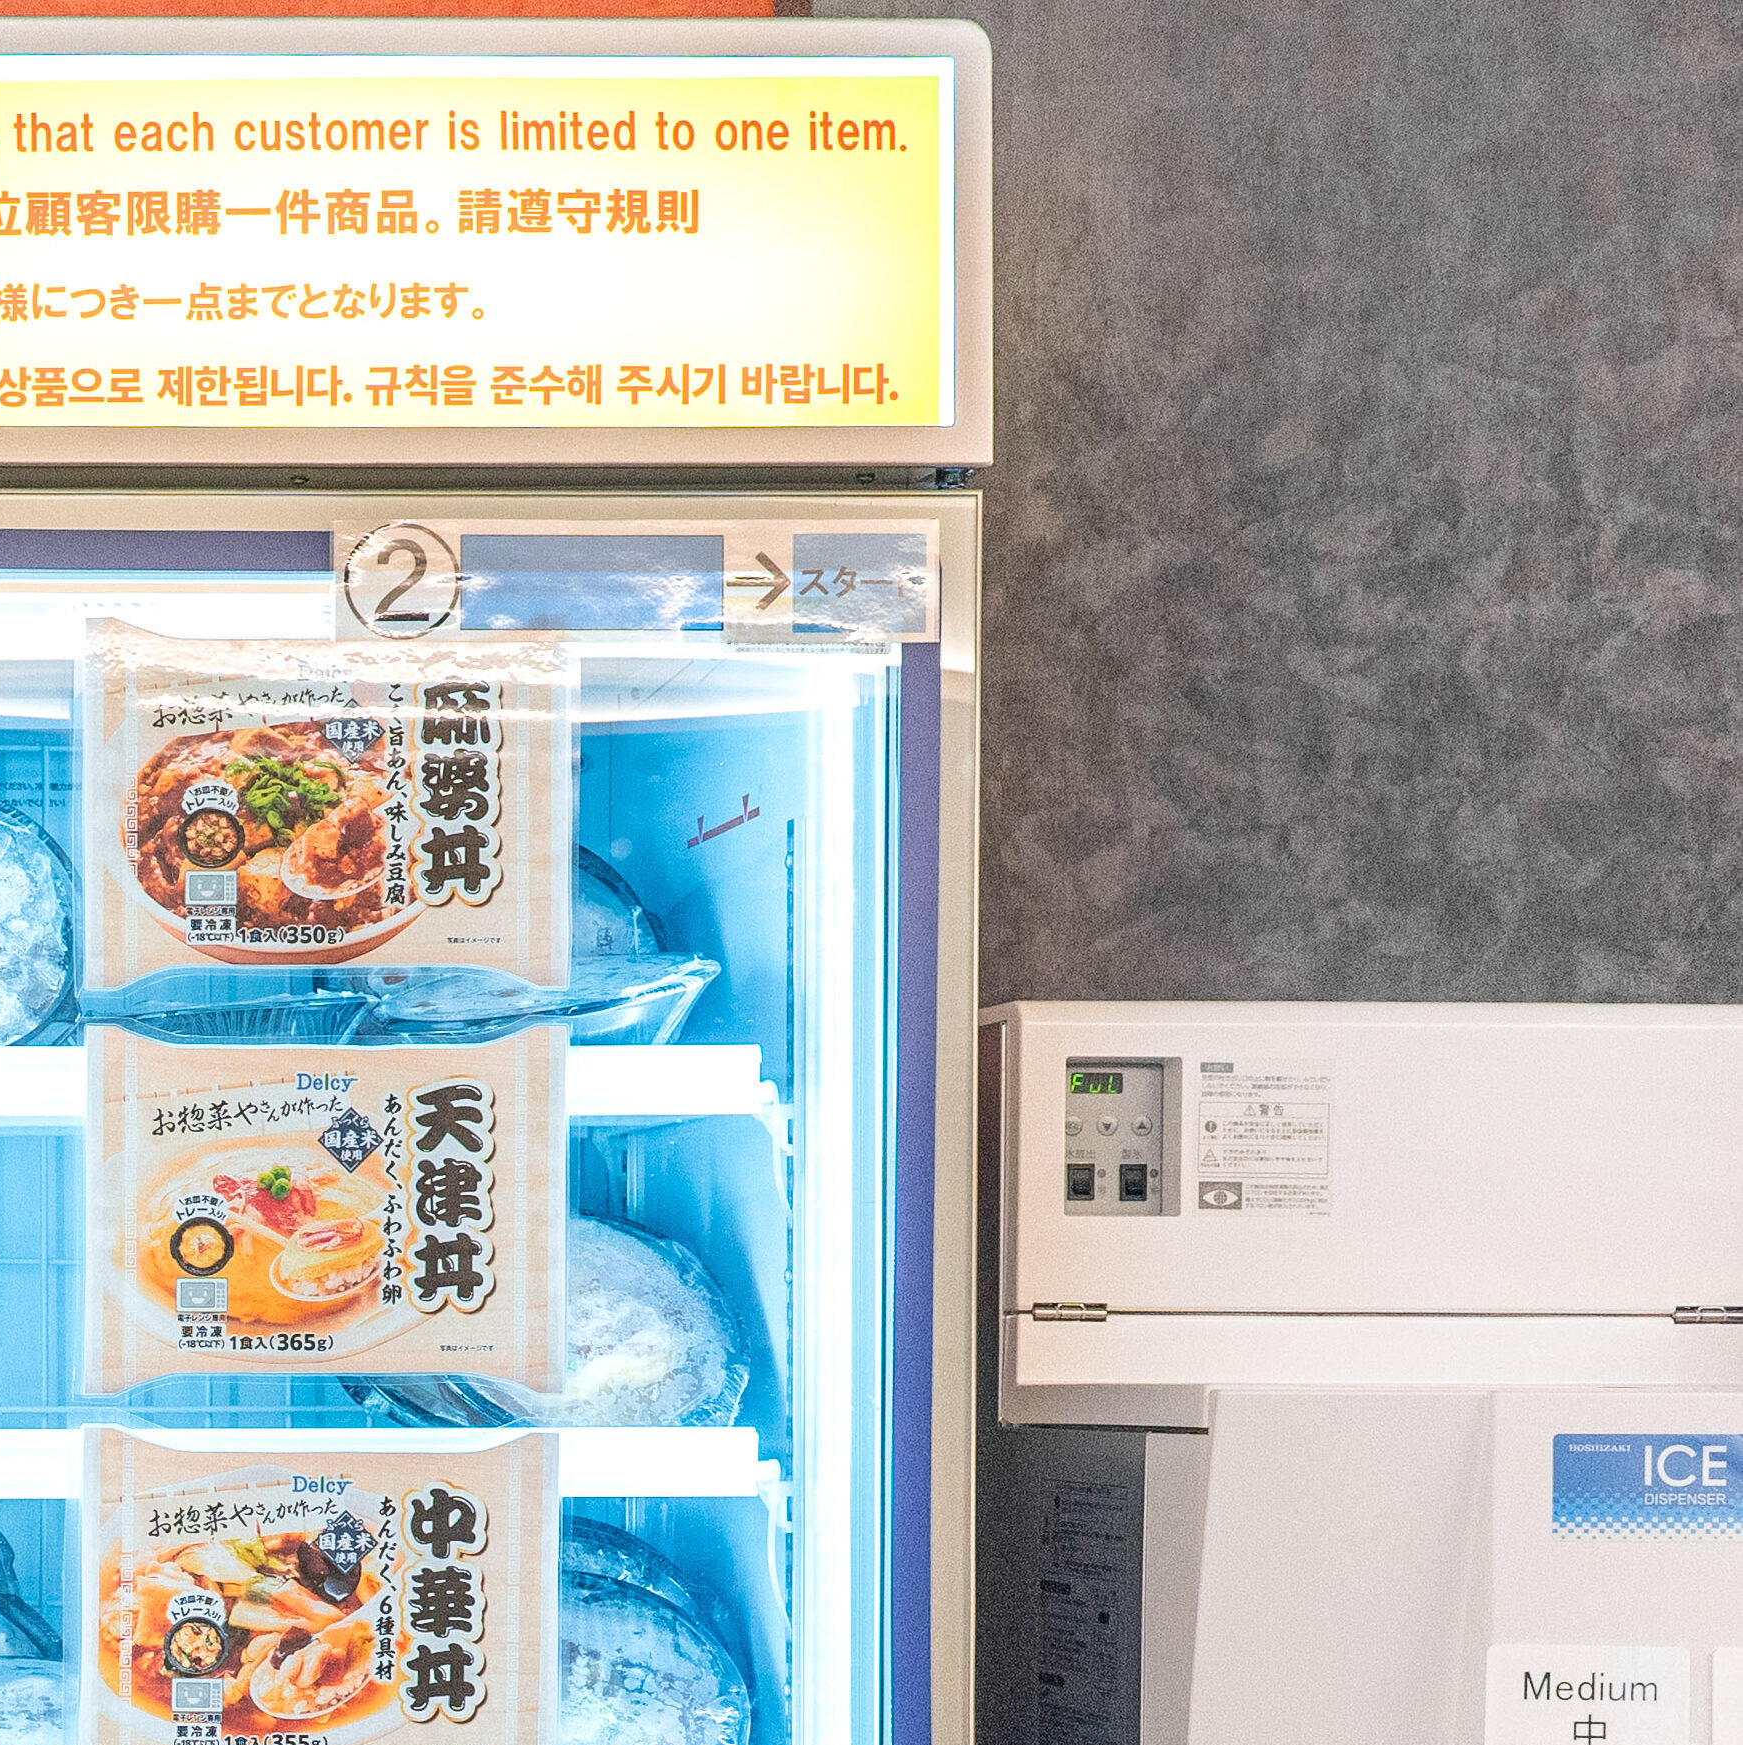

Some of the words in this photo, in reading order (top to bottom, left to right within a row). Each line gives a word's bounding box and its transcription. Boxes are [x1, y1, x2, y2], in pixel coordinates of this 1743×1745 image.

[12, 112, 94, 154] that
[113, 111, 214, 153] each
[233, 112, 430, 152] customer
[447, 110, 481, 152] is
[499, 109, 636, 152] limited
[654, 111, 695, 152] to
[714, 119, 790, 152] one
[808, 110, 907, 153] item.
[156, 364, 353, 408] 제한됩니다.
[364, 364, 477, 407] 규칙을
[489, 363, 603, 407] 준수해
[615, 363, 726, 406] 주시기
[740, 362, 899, 406] 바랍니다.
[324, 718, 383, 741] 国産米
[189, 918, 233, 931] 要冷凍
[296, 1072, 357, 1095] Delcy
[151, 1094, 345, 1137] お惣菜やさんが作った
[324, 1130, 380, 1149] 国産米
[340, 1149, 364, 1162] 使用
[381, 1092, 403, 1306] あんだく、ふわふわ卵
[414, 1085, 485, 1302] 天津丼
[180, 1325, 223, 1339] 要冷凍
[1569, 1443, 1632, 1453] HOSHIZAKI
[1643, 1444, 1728, 1488] ICE
[291, 1475, 353, 1496] Delcy
[1644, 1492, 1727, 1506] DISPENSER
[147, 1497, 339, 1538] お惣菜やさんが作った
[318, 1533, 375, 1553] 国産米
[409, 1488, 478, 1712] 中華丼
[1523, 1670, 1658, 1702] Medium
[176, 1725, 219, 1738] 要冷凍
